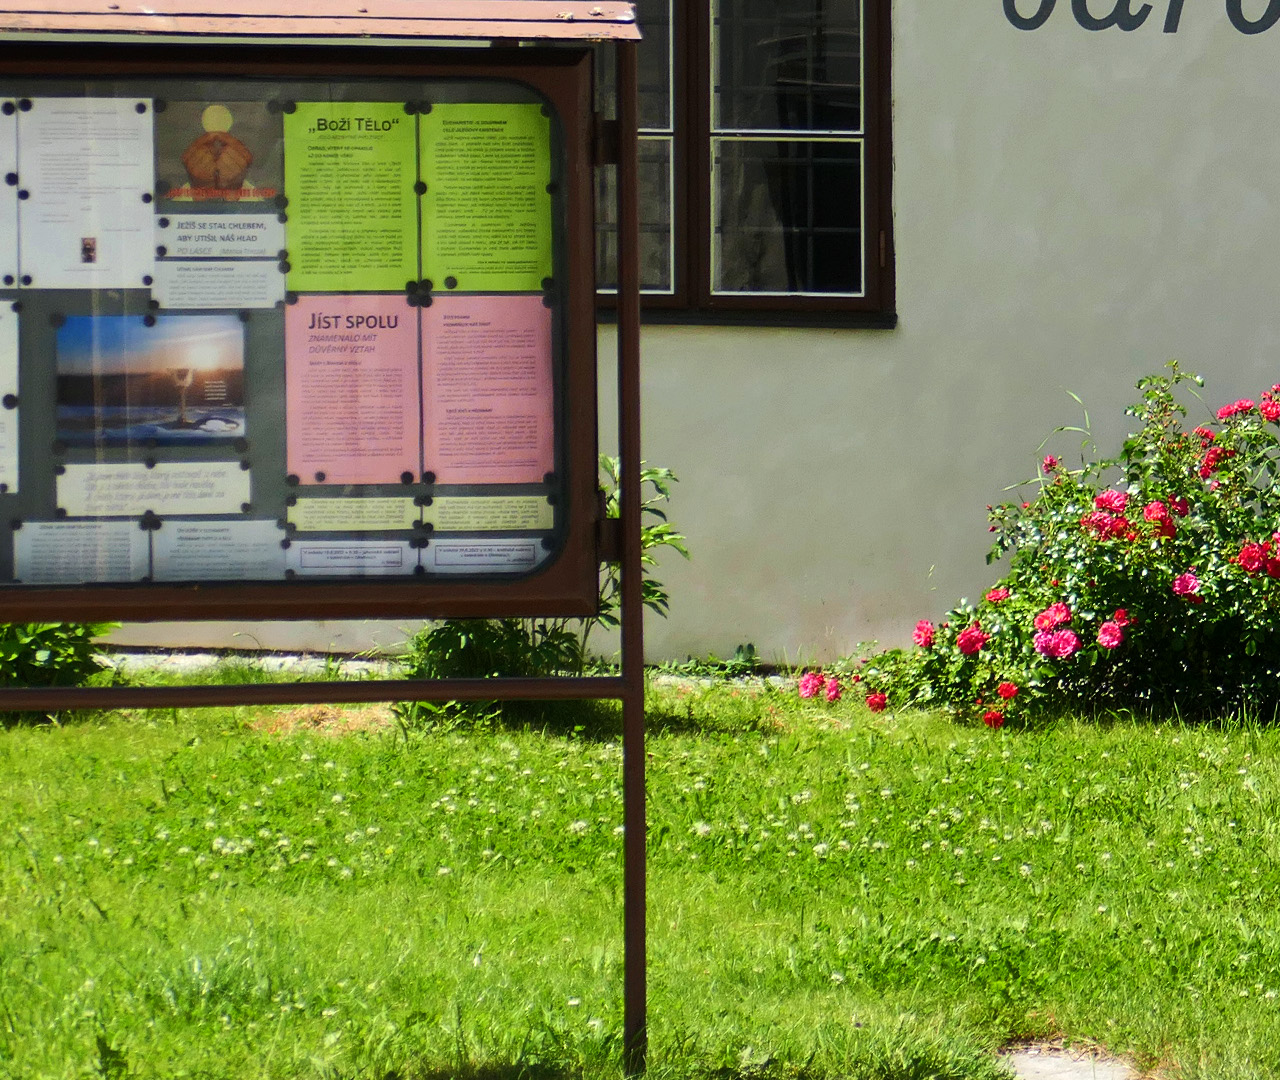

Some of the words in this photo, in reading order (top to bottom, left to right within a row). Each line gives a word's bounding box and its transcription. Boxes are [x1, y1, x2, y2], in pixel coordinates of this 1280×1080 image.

[308, 312, 341, 329] JÍST
[346, 315, 398, 329] SPOLU
[308, 334, 361, 342] ZNAMENALO
[350, 346, 376, 354] VZTAH
